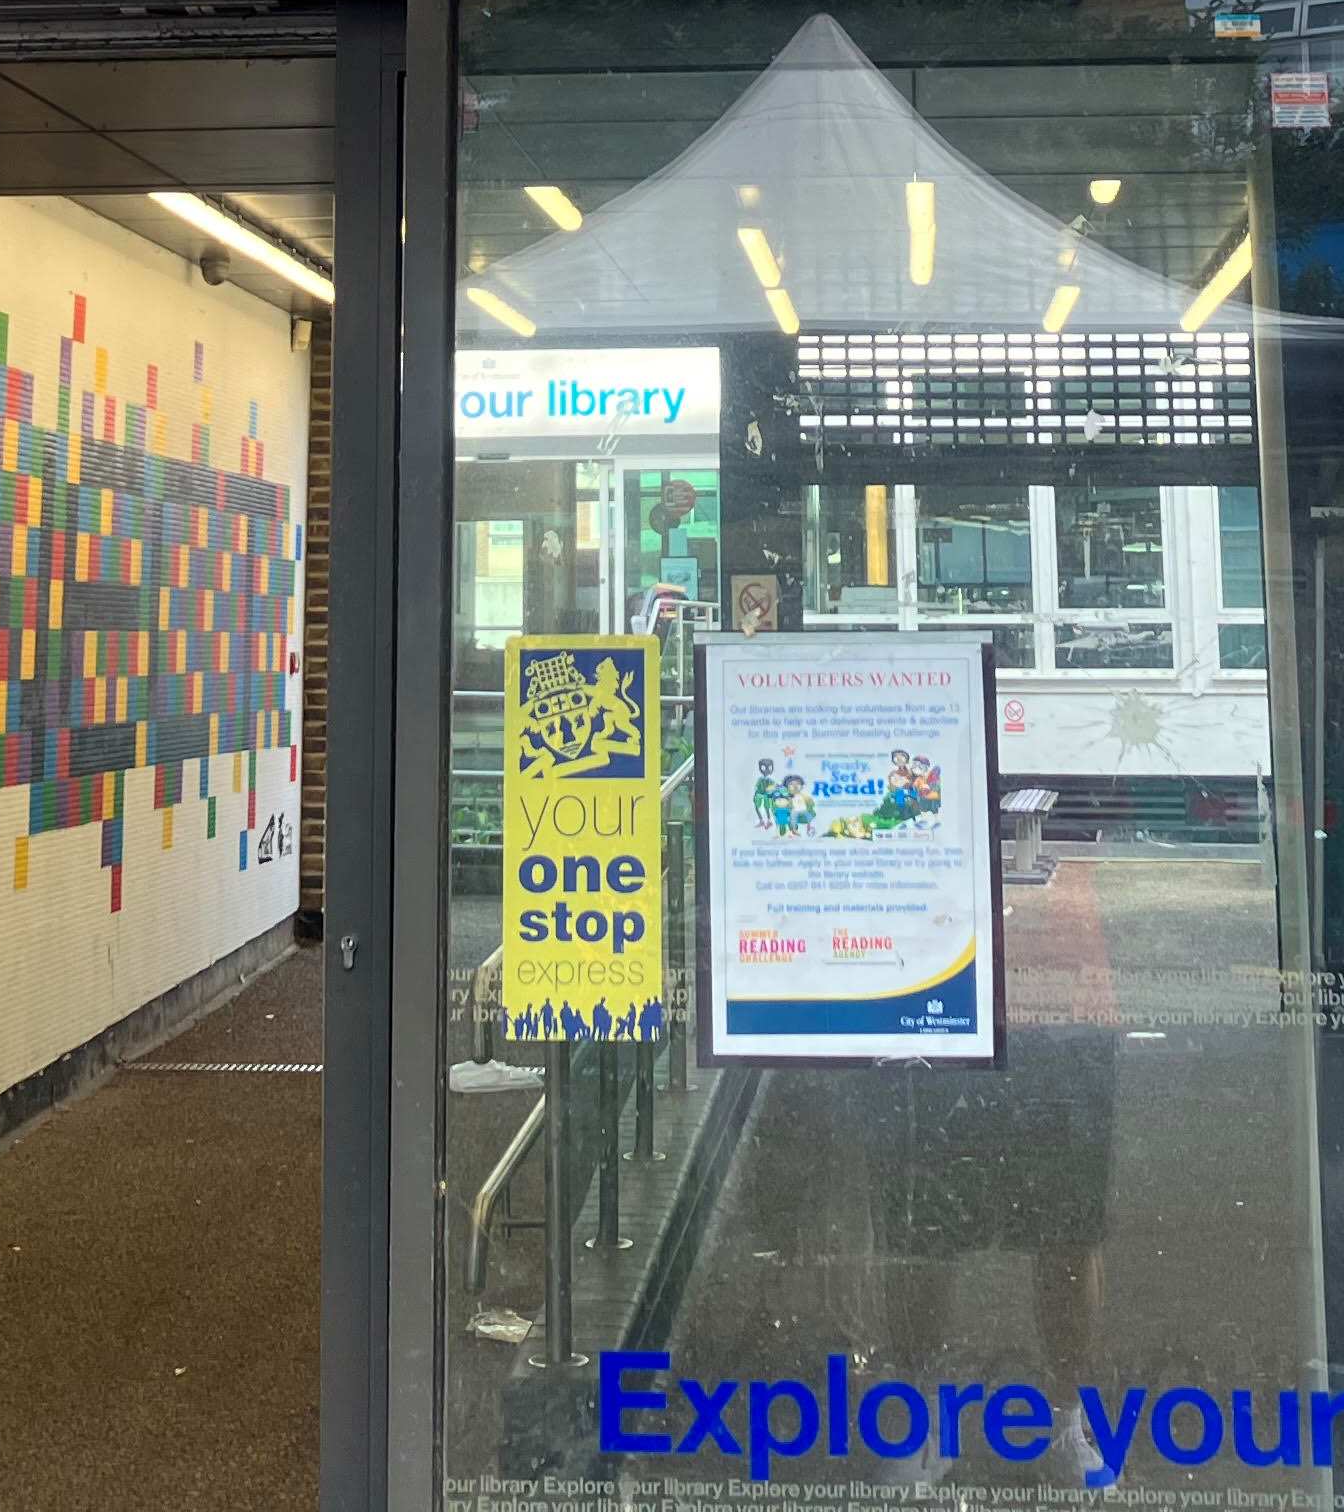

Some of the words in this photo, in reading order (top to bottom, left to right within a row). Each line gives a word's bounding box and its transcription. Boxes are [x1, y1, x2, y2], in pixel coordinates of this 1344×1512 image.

[548, 380, 685, 423] library
[736, 672, 863, 688] VOLUNTEERS
[869, 671, 952, 687] WANTED
[812, 778, 884, 797] Read!
[520, 795, 645, 851] your
[518, 854, 646, 893] one
[518, 901, 646, 954] stop
[833, 936, 894, 951] READING
[739, 938, 807, 953] READING
[517, 959, 644, 993] express
[1255, 1008, 1327, 1029] Explore
[599, 1351, 1053, 1480] Explore
[480, 1475, 539, 1497] library
[544, 1476, 614, 1497] Explore
[664, 1476, 724, 1499] library
[728, 1478, 801, 1500] Explore
[802, 1483, 847, 1501] your
[850, 1480, 910, 1502] library
[915, 1481, 987, 1505] Explore
[991, 1486, 1035, 1503] your
[1037, 1482, 1097, 1505] library
[1103, 1485, 1176, 1507] Explore
[1180, 1490, 1225, 1508] your
[1227, 1488, 1288, 1510] library
